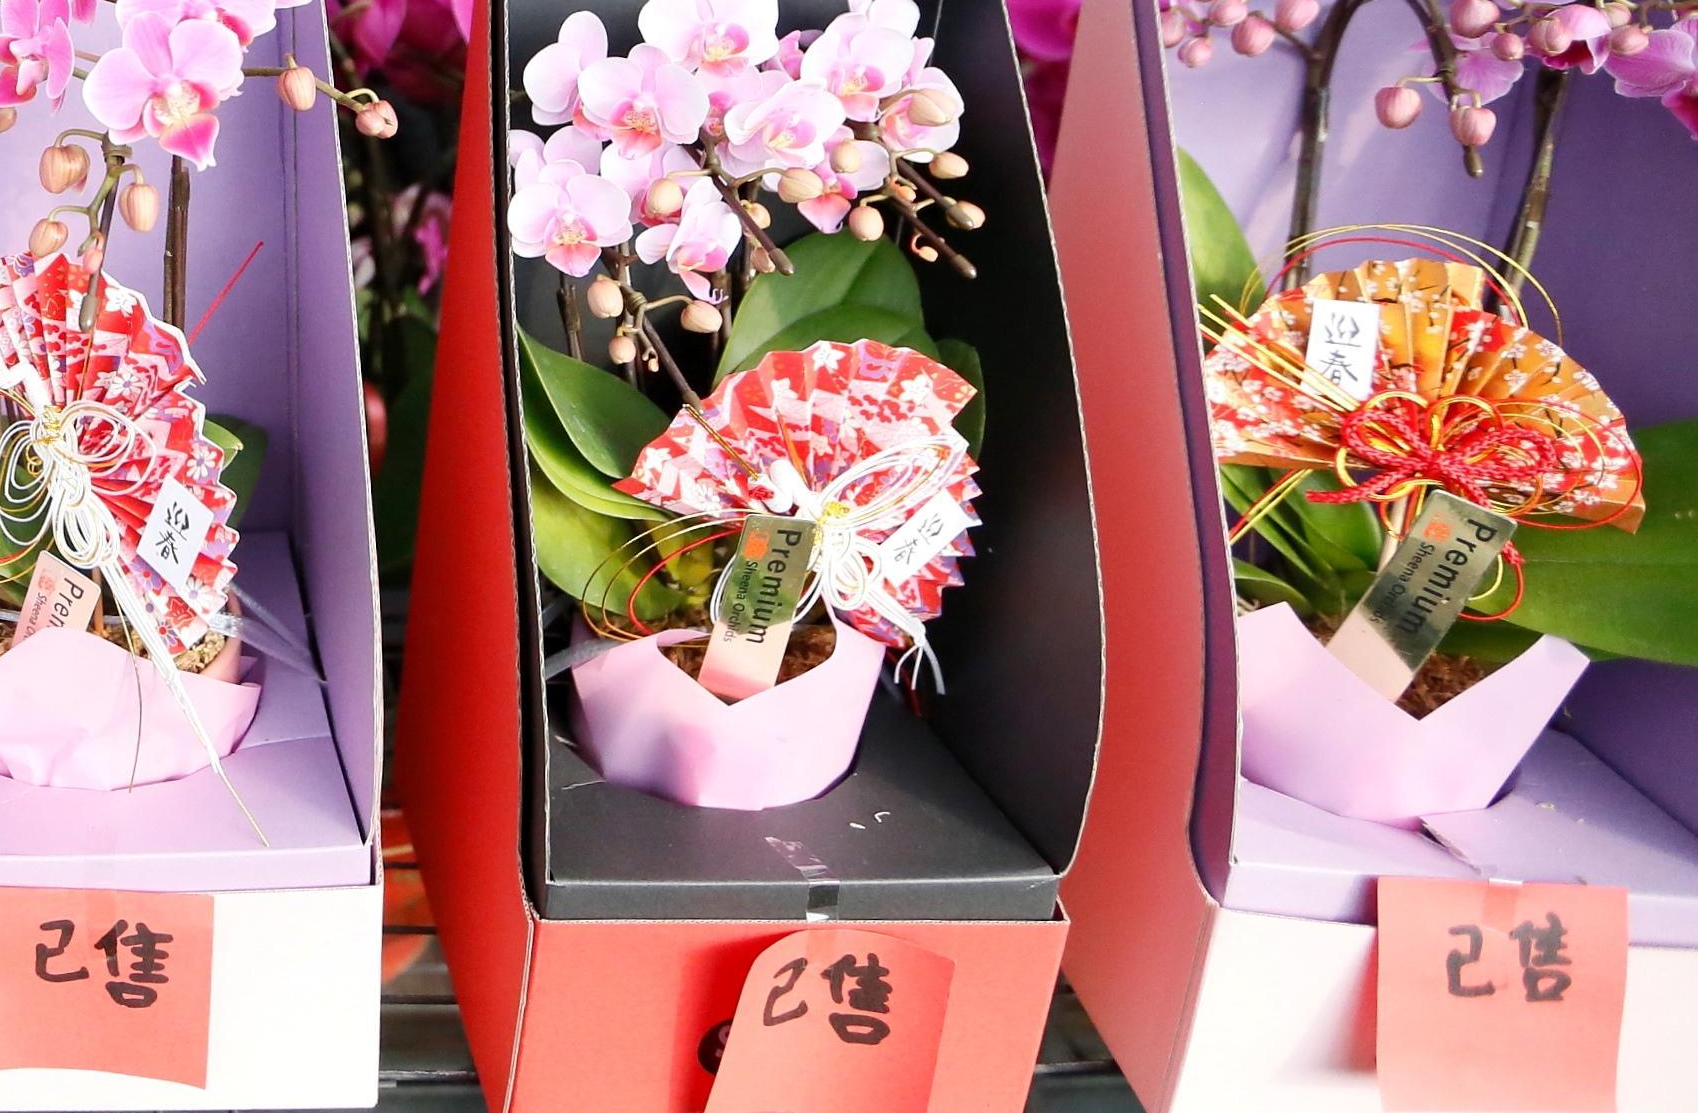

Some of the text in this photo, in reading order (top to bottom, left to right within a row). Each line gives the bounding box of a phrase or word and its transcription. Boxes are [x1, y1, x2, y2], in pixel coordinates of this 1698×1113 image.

[1320, 312, 1362, 385] 迎春
[155, 501, 190, 565] 迎春
[1399, 541, 1436, 584] Sheena
[29, 592, 47, 626] Sheena
[723, 560, 758, 642] Sheena Orchids
[745, 529, 802, 644] Premium
[1396, 518, 1498, 634] Premium
[35, 919, 174, 1008] 已售
[763, 953, 893, 1045] 已售
[1446, 911, 1573, 1003] 已售
